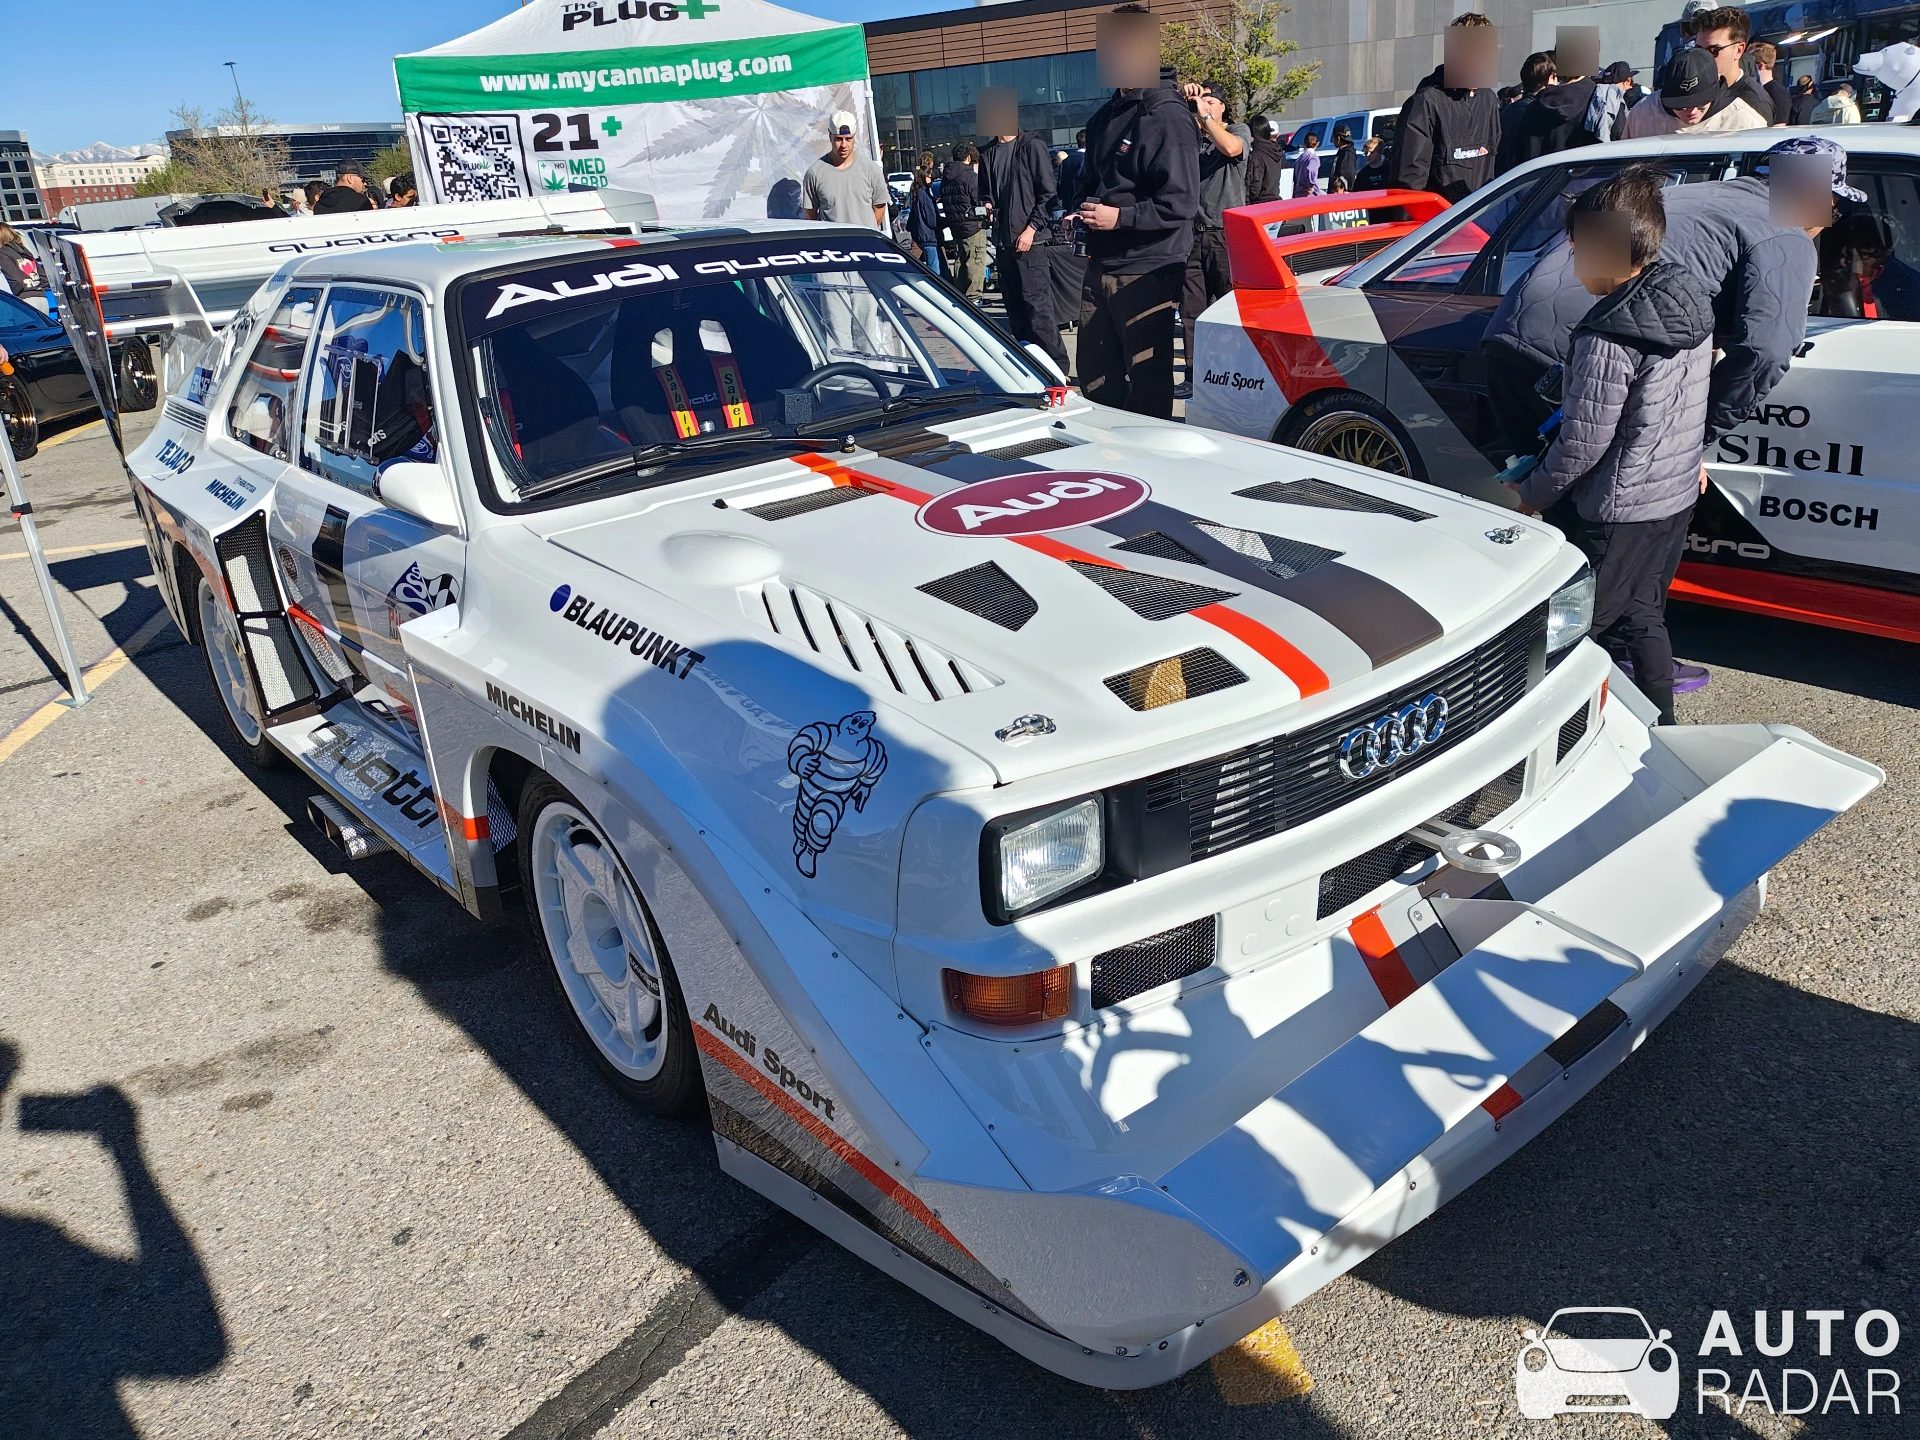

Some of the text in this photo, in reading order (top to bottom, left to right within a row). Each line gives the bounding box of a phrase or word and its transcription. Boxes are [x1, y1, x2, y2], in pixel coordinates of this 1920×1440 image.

[561, 0, 599, 13] The
[479, 54, 792, 93] www.mycannaplug.com
[568, 157, 606, 175] MED
[268, 229, 460, 253] quattro
[693, 249, 907, 275] quattro
[1202, 369, 1266, 391] Audi Sport
[664, 369, 694, 437] Sabelt
[723, 373, 743, 427] Sabel
[1741, 403, 1811, 429] ARO
[154, 438, 196, 475] TEXACO
[1716, 433, 1865, 477] Shell
[204, 478, 248, 511] MICHELIN
[1759, 495, 1879, 531] BOSCH
[562, 594, 707, 681] BLAUPUNKT
[485, 680, 582, 756] MICHELIN
[306, 720, 441, 829] quatt
[702, 1002, 836, 1122] Audi Sport
